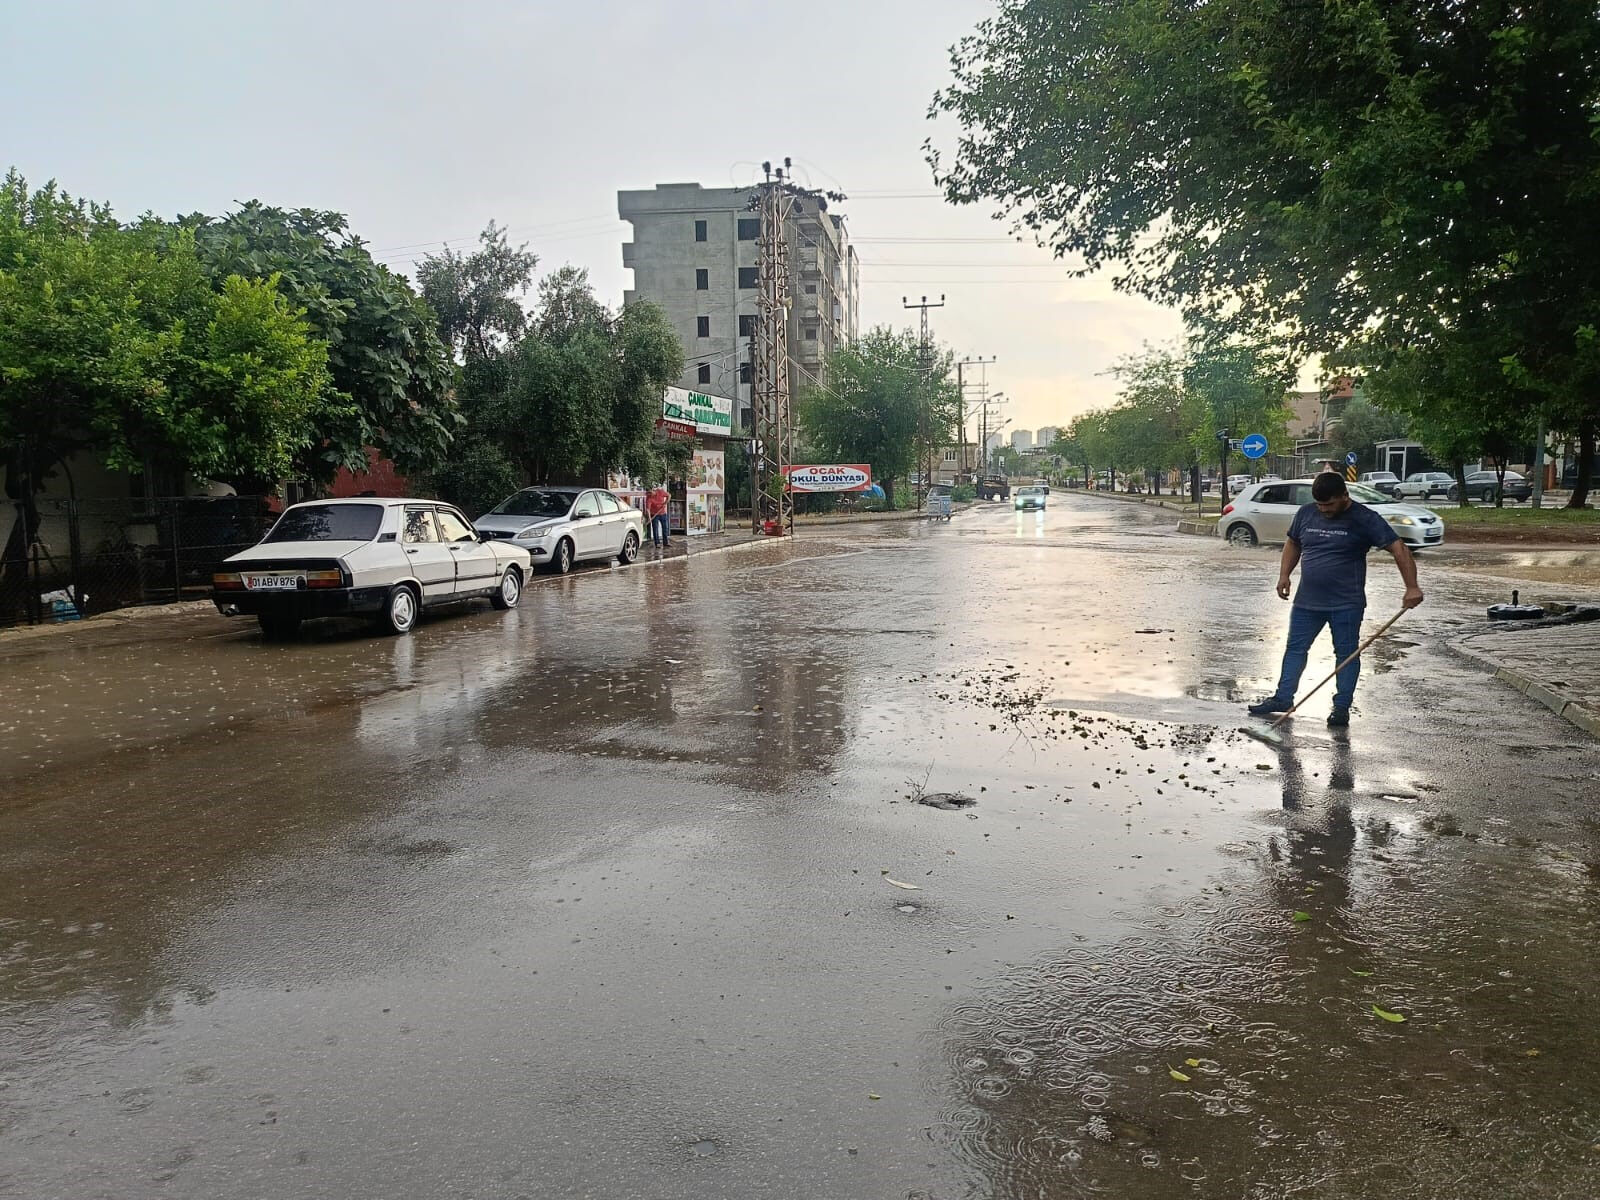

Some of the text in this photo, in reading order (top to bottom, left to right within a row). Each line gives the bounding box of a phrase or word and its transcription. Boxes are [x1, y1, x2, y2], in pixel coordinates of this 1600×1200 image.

[252, 577, 295, 587] 01 ABV 876
